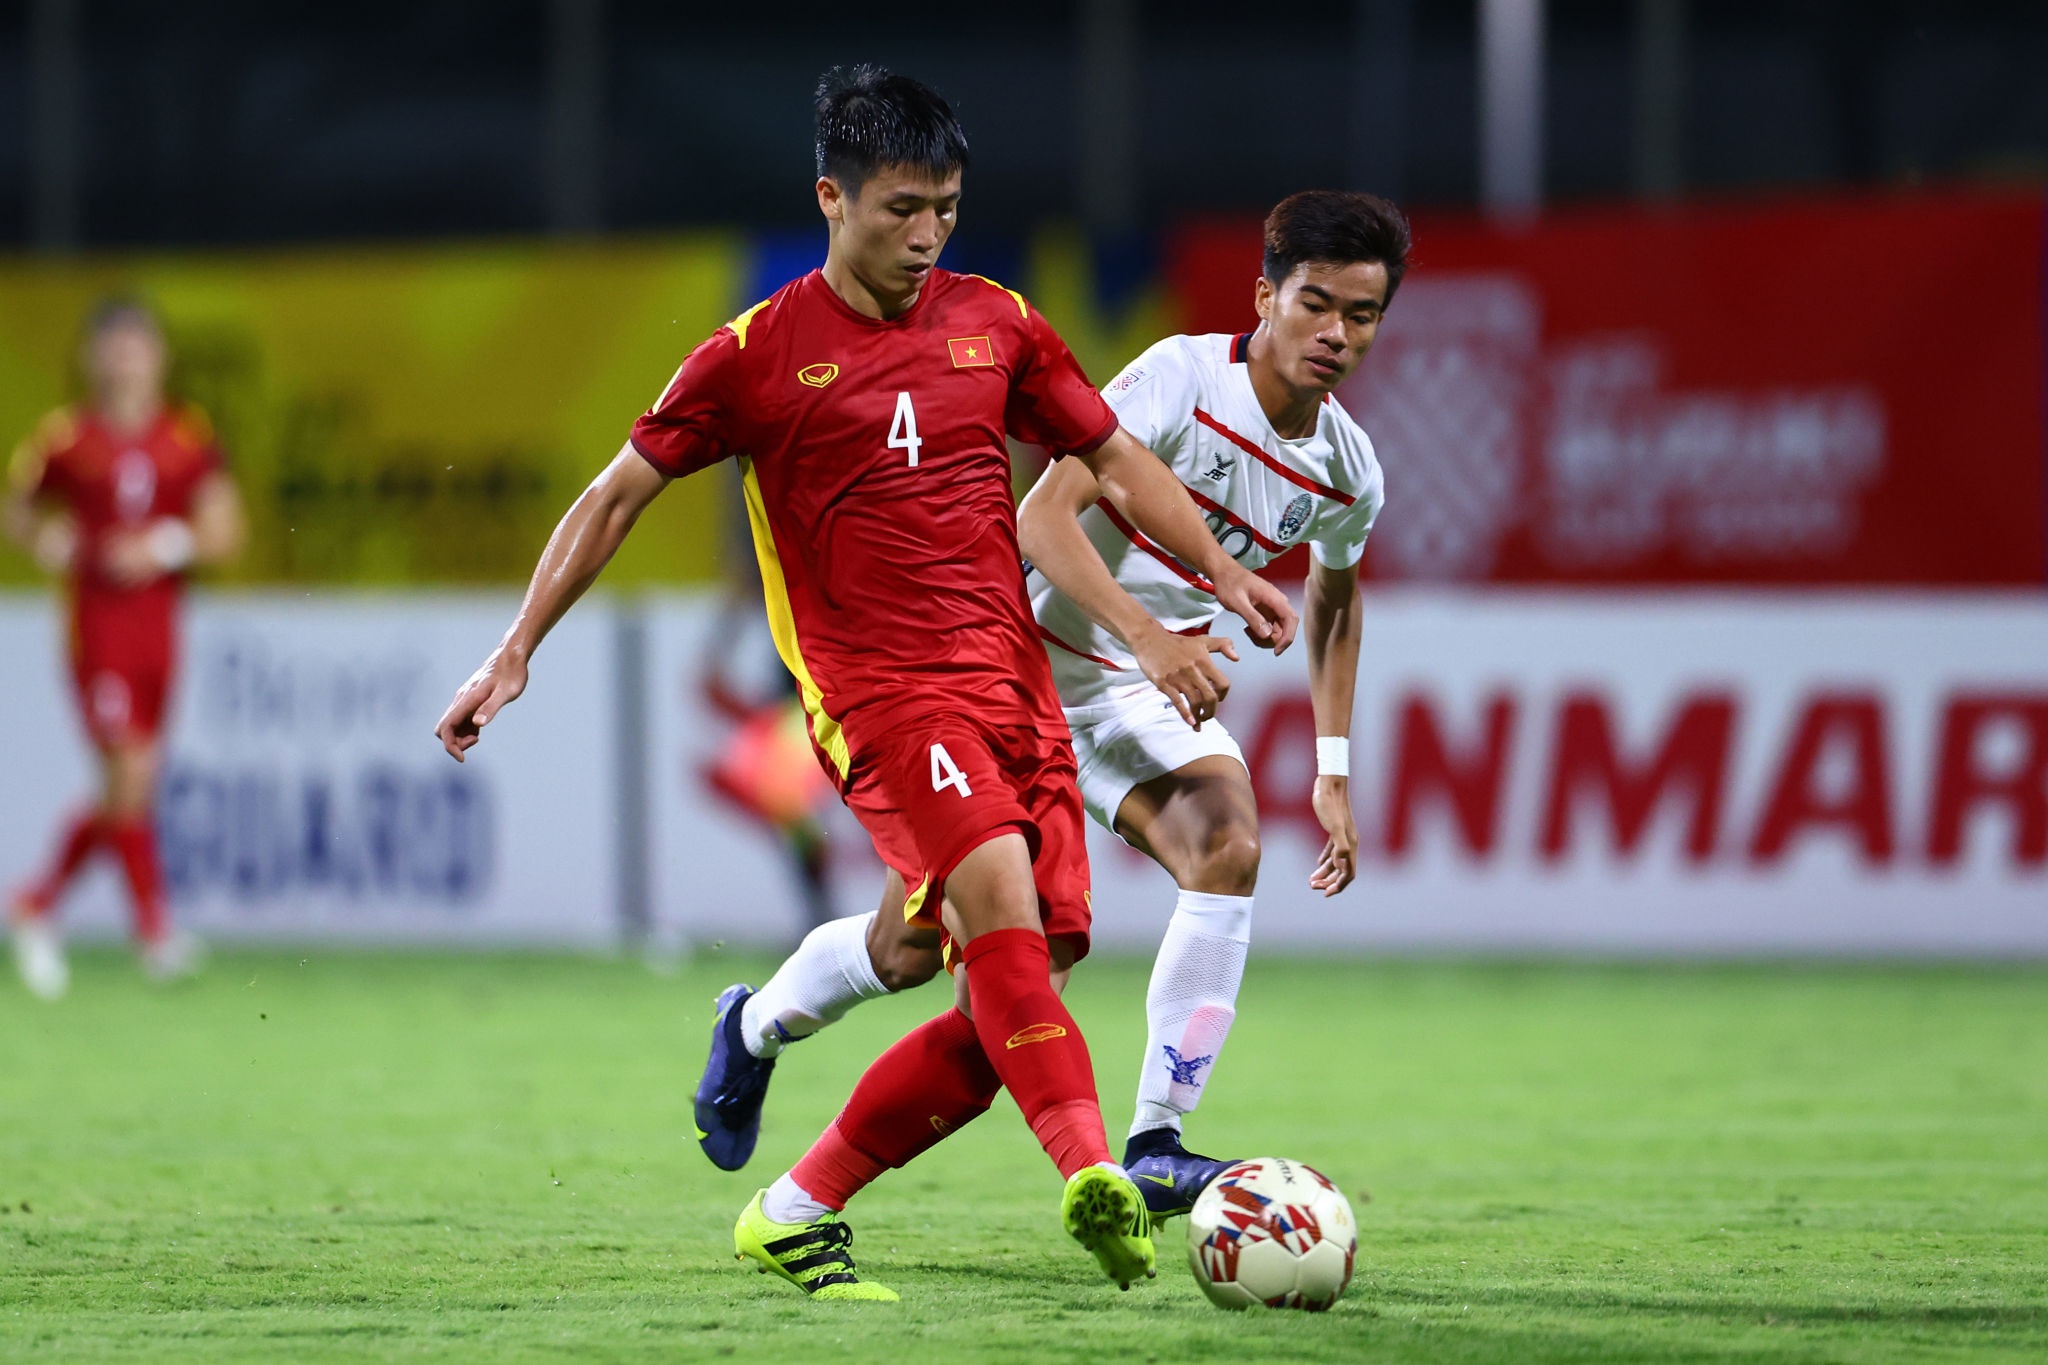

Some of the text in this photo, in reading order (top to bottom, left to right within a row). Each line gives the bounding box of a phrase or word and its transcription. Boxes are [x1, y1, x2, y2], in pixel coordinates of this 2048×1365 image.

[887, 391, 922, 467] 4
[930, 742, 973, 798] 4
[1118, 688, 2048, 864] ANMAR
